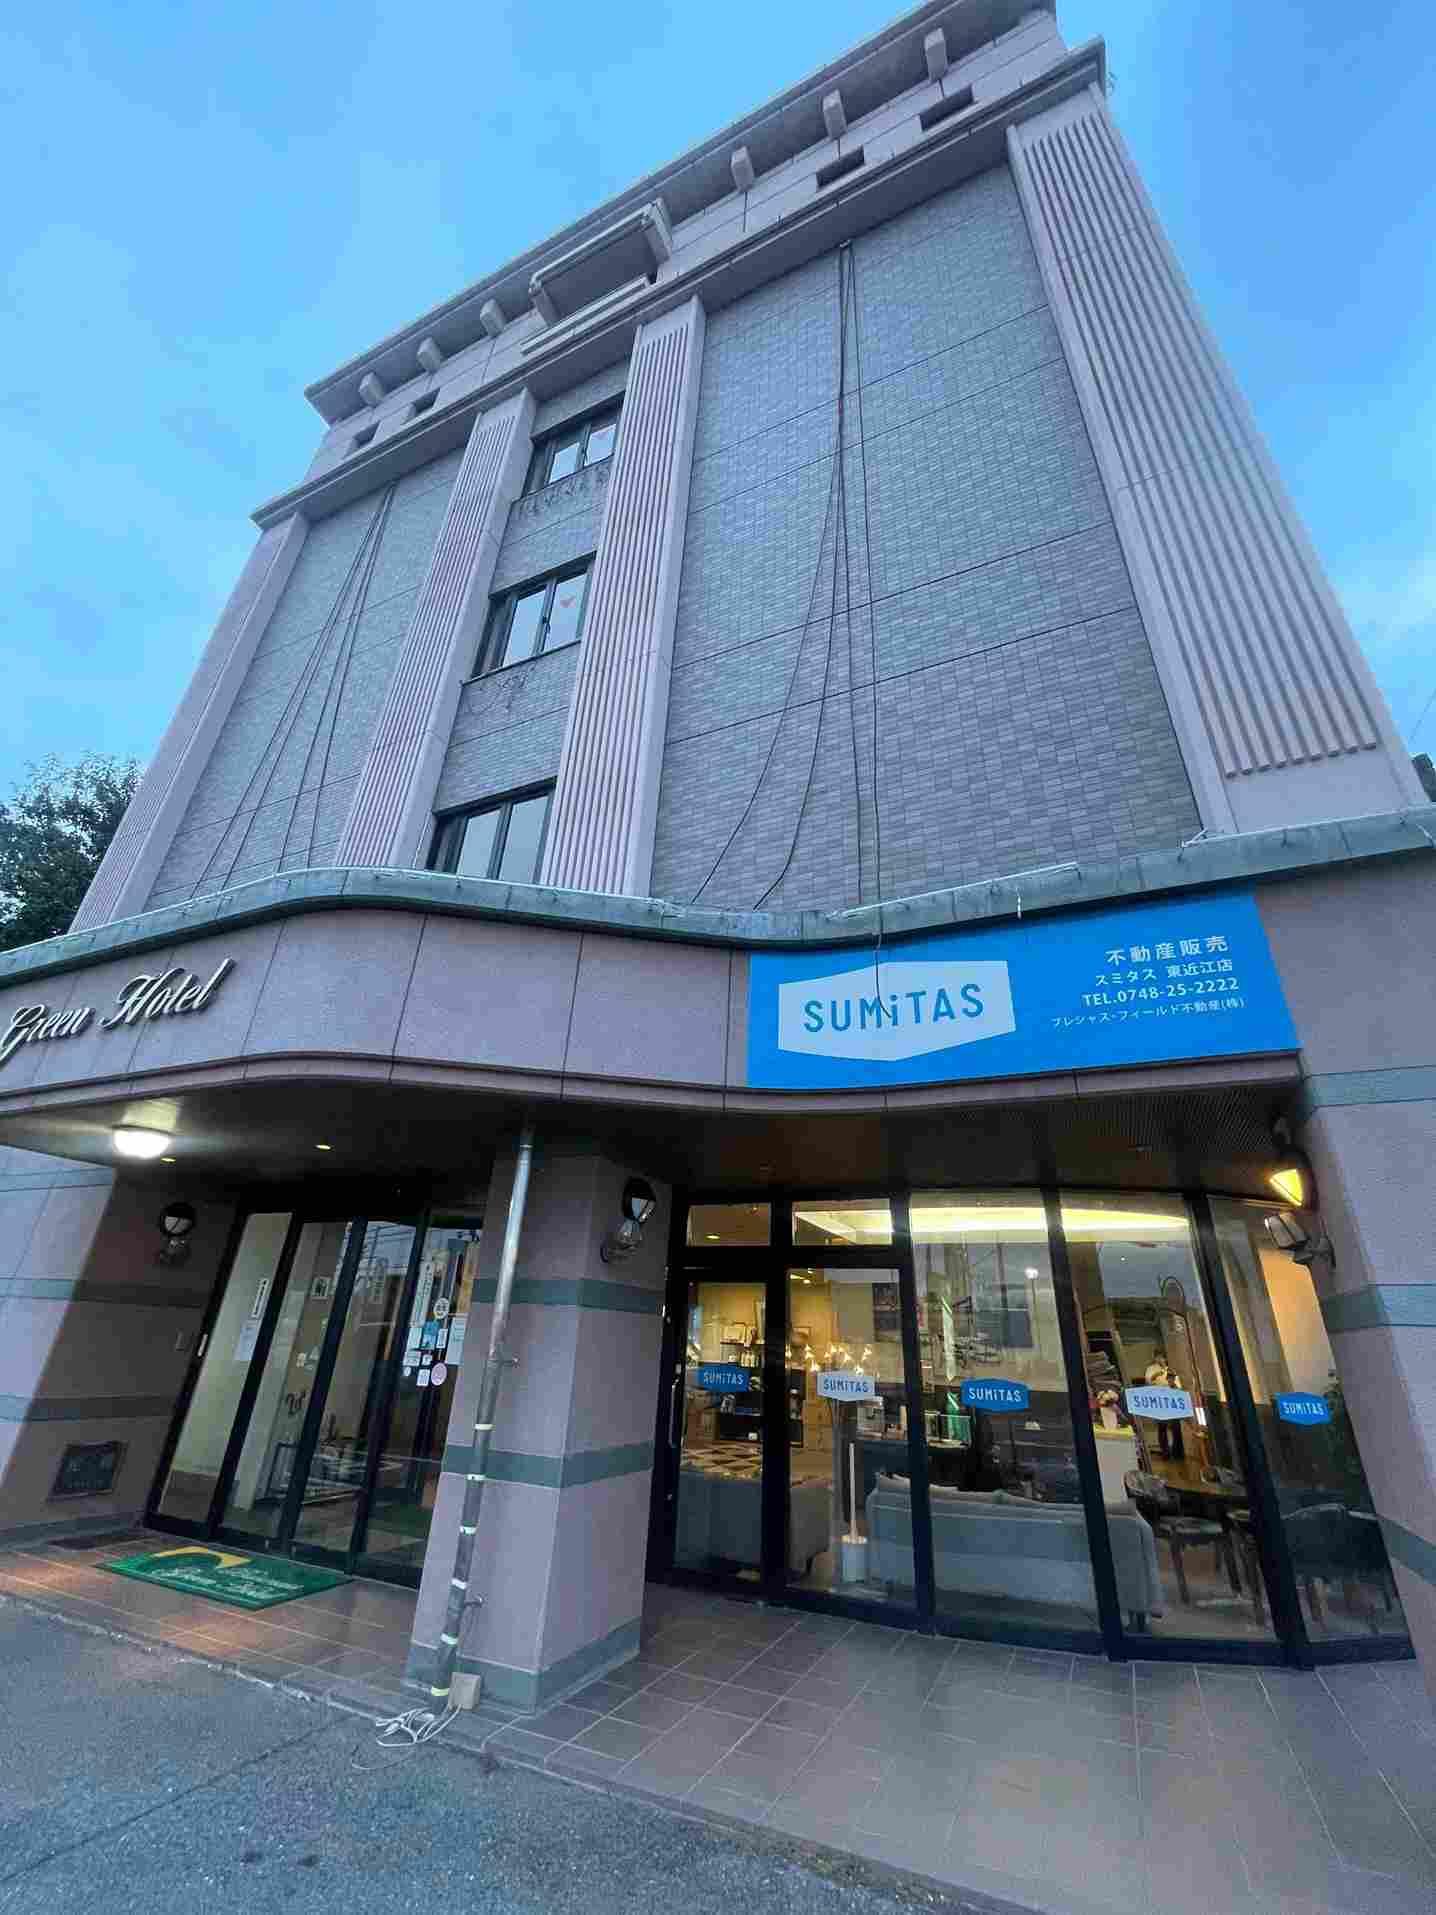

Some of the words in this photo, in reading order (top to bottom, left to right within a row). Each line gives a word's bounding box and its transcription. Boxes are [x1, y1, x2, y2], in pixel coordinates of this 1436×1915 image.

[1105, 935, 1229, 966] 不動産販売
[1095, 968, 1157, 987] スミタス
[1166, 959, 1233, 978] 東近江店
[0, 1003, 91, 1063] Green
[100, 957, 236, 1030] Hotel
